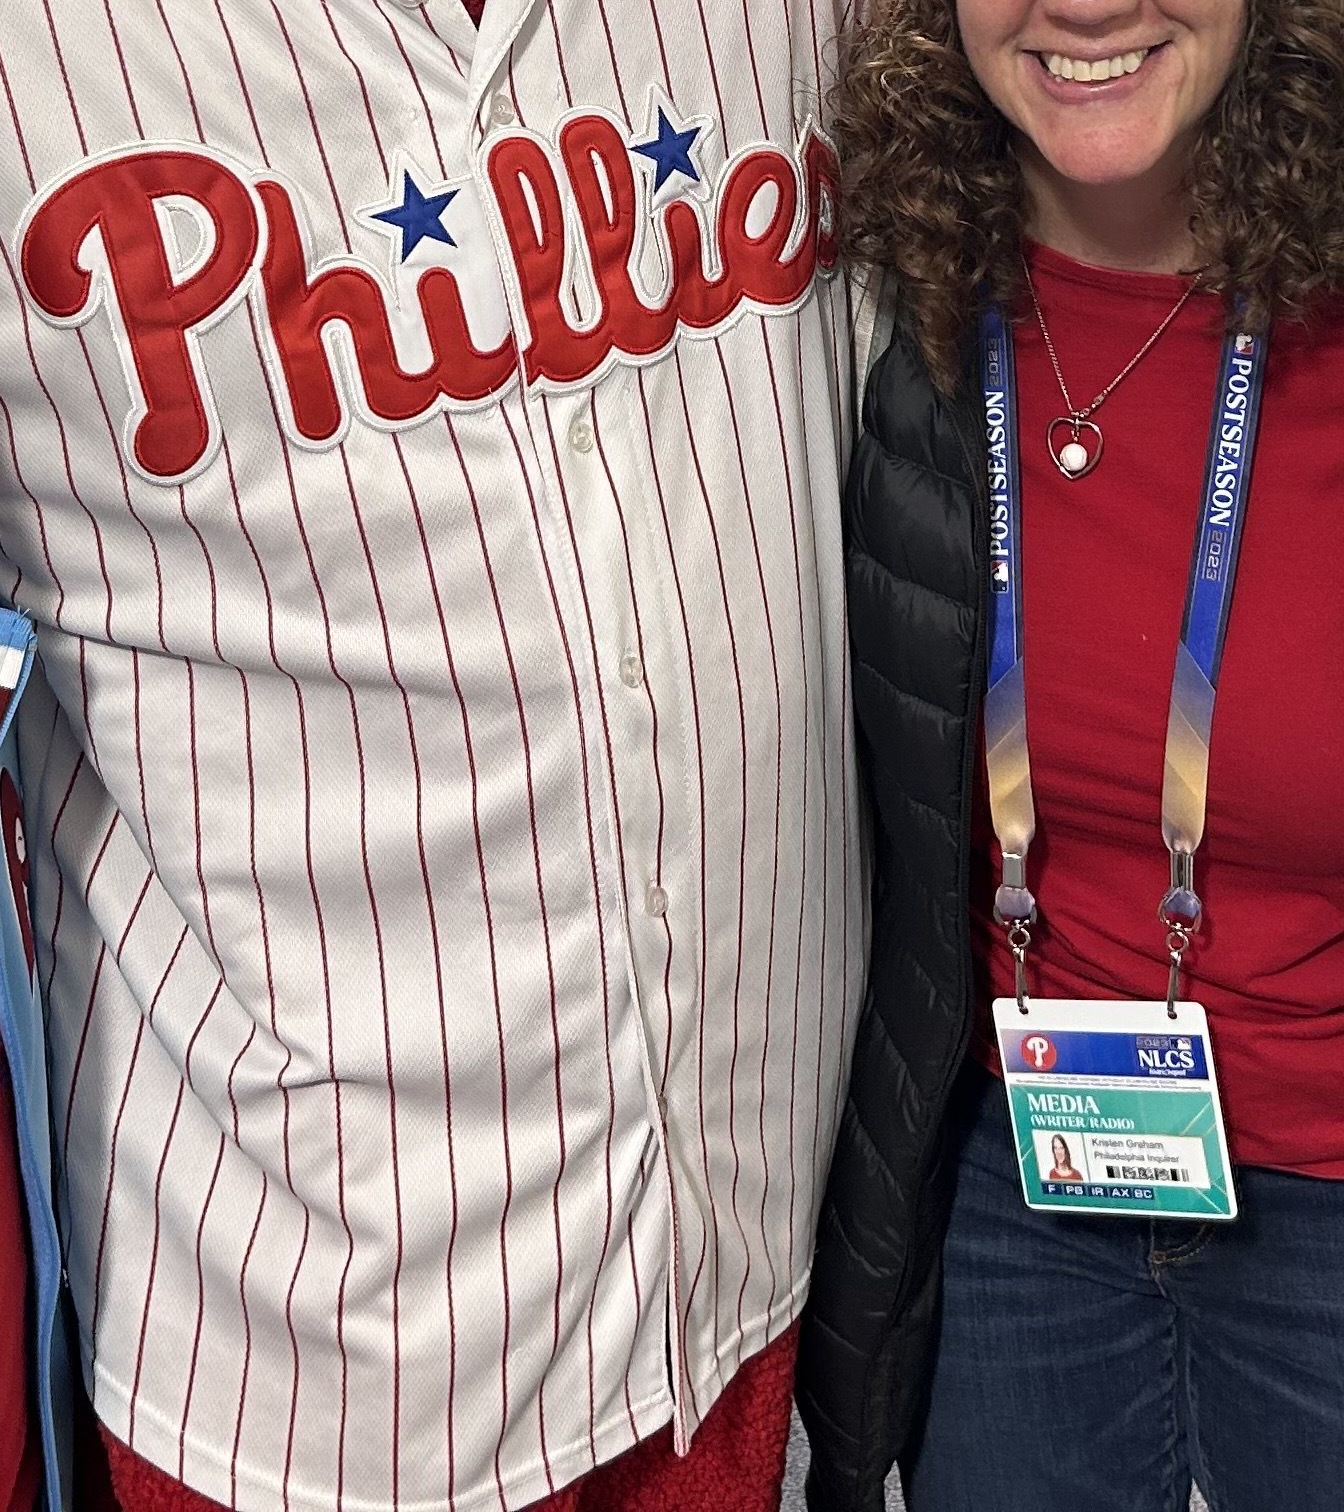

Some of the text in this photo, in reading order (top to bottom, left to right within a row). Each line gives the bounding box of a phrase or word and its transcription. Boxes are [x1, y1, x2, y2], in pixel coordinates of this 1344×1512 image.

[986, 390, 1009, 557] POSTSEASON
[1204, 358, 1253, 582] POSTSEASON 2023
[1137, 1049, 1195, 1069] NLCS
[1027, 1093, 1100, 1114] MEDIA
[1031, 1115, 1135, 1129] (WRITER/RADIO)
[1066, 1185, 1083, 1195] PB
[1091, 1187, 1103, 1196] IR
[1112, 1188, 1130, 1198] AX
